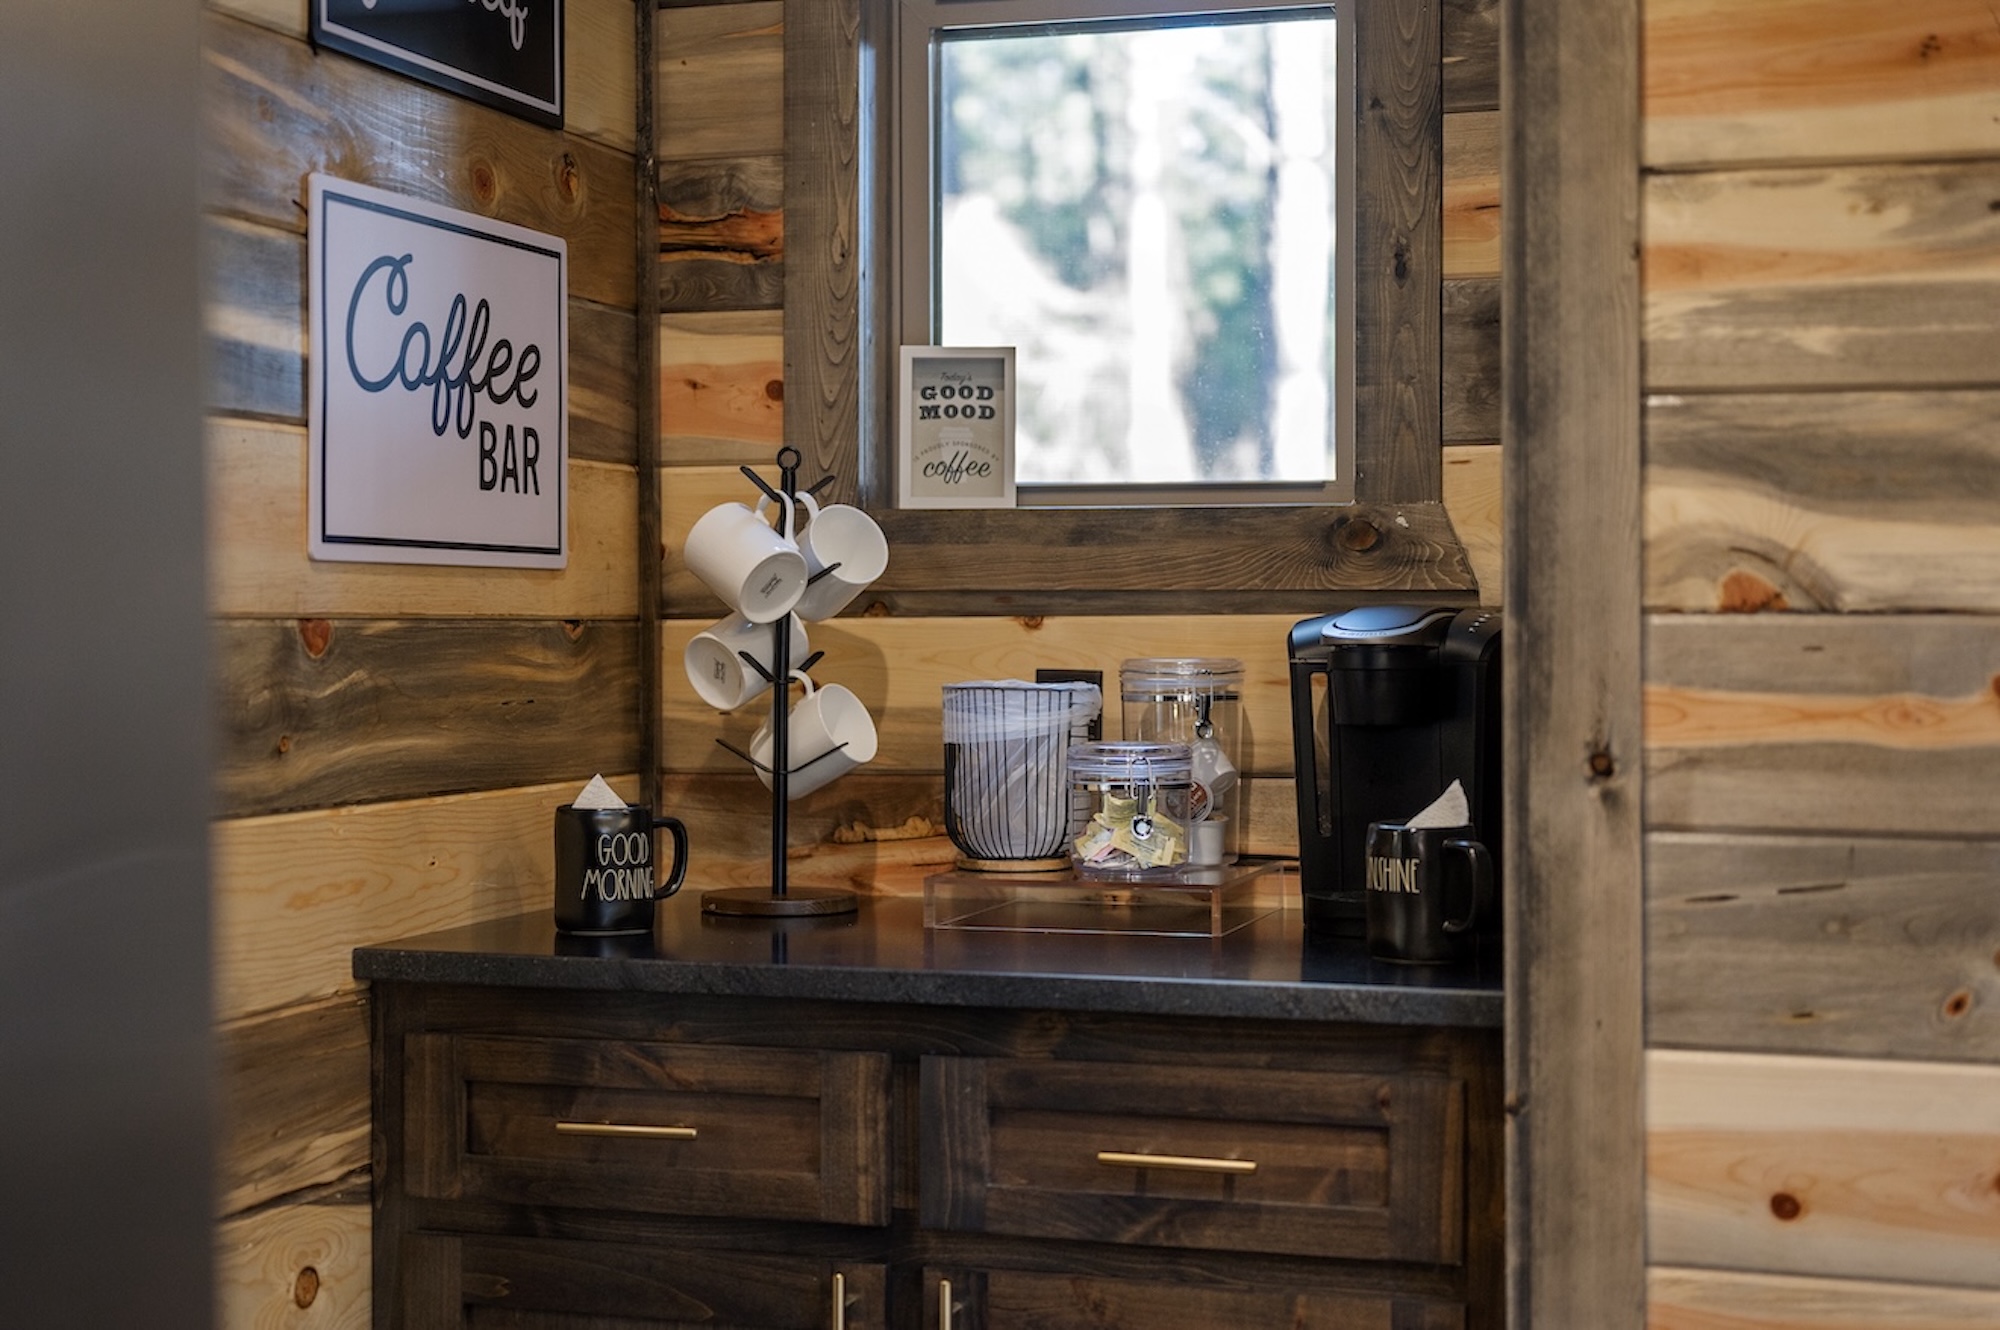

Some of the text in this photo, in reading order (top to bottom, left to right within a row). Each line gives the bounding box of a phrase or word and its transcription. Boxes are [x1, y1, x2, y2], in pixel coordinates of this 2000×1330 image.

[346, 253, 540, 439] Coffee
[920, 385, 994, 401] GOOD
[940, 372, 972, 386] Today's
[919, 404, 996, 420] MOOD
[479, 421, 540, 496] BAR
[923, 450, 992, 484] coffee
[598, 832, 649, 866] GOOD
